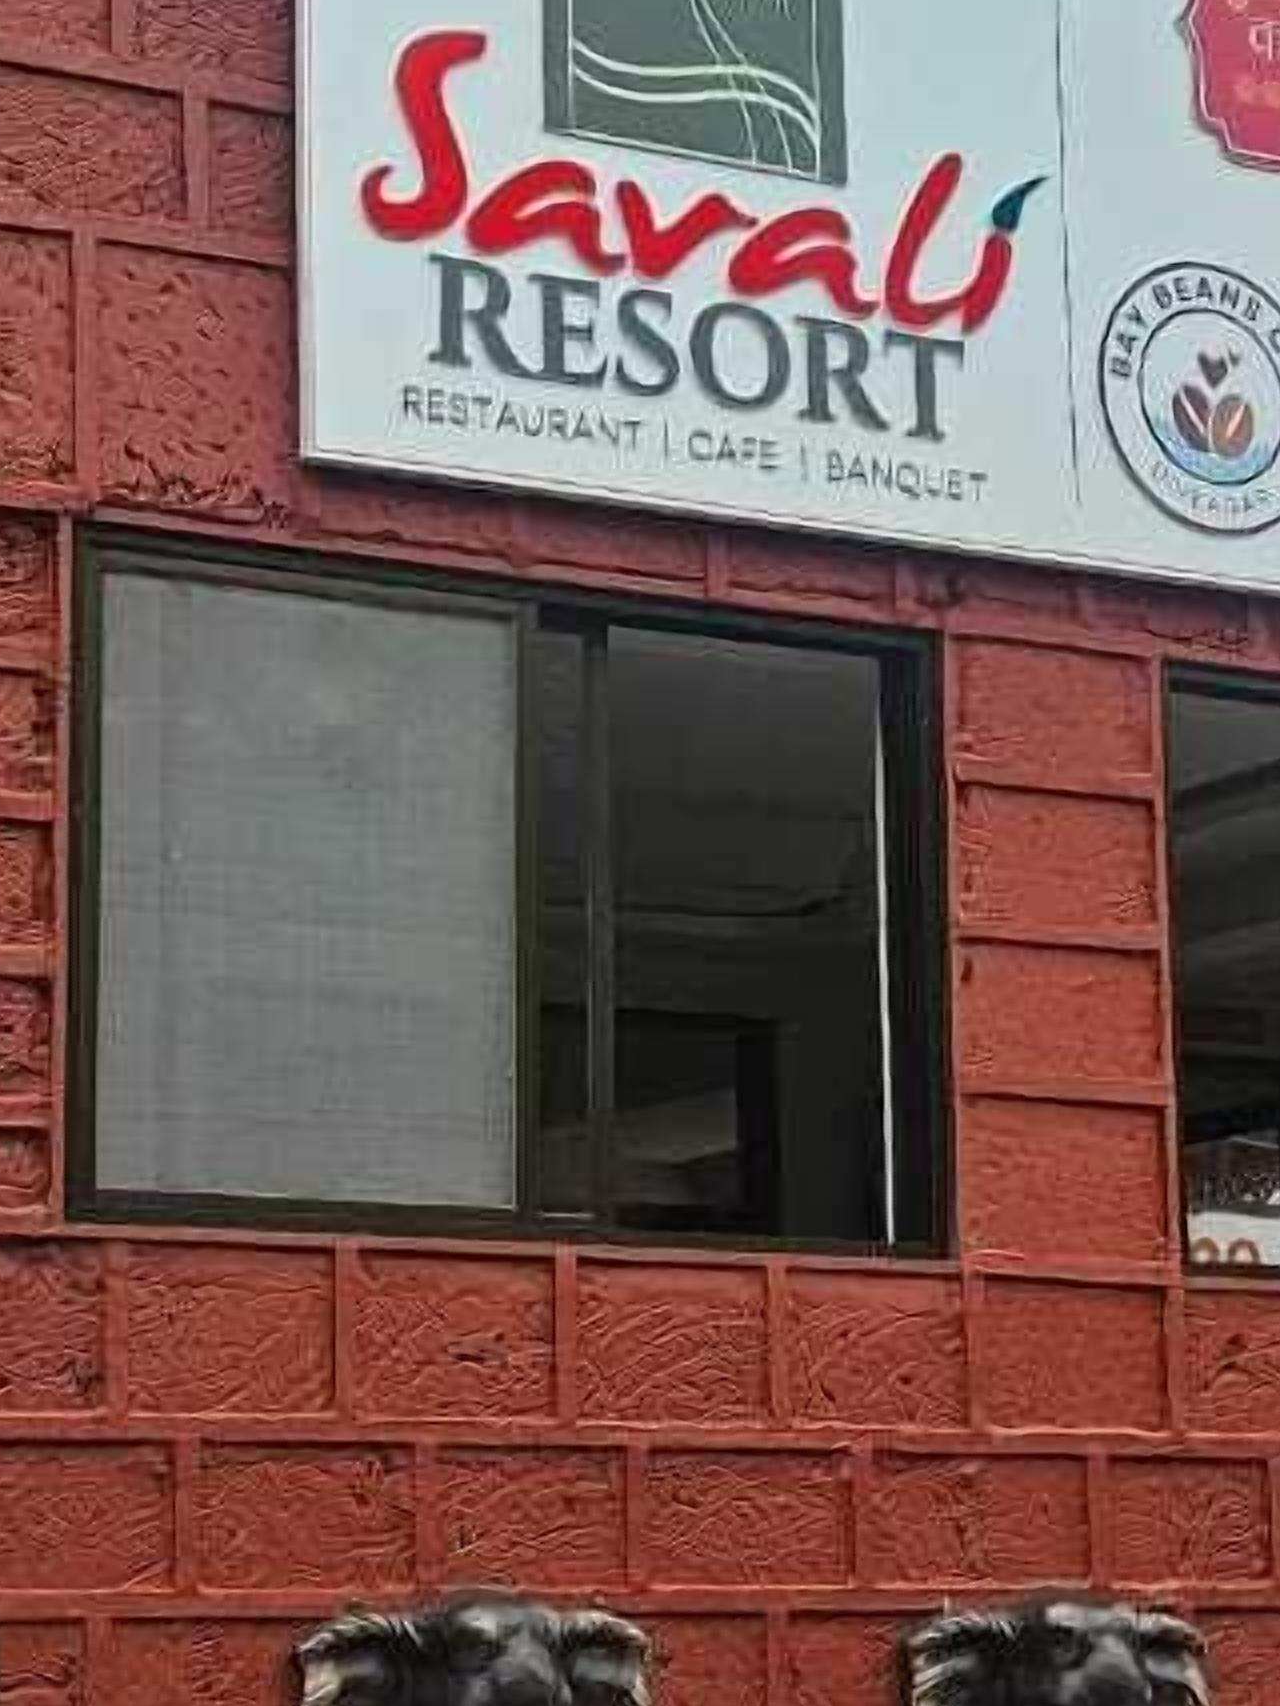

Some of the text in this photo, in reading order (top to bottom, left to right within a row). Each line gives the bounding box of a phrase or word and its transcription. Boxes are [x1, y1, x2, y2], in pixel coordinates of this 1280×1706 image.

[361, 31, 1047, 334] Savali
[429, 253, 965, 441] RESORT
[1110, 304, 1149, 379] BAY
[403, 384, 989, 502] RESTAURANT CAFE BANQUET
